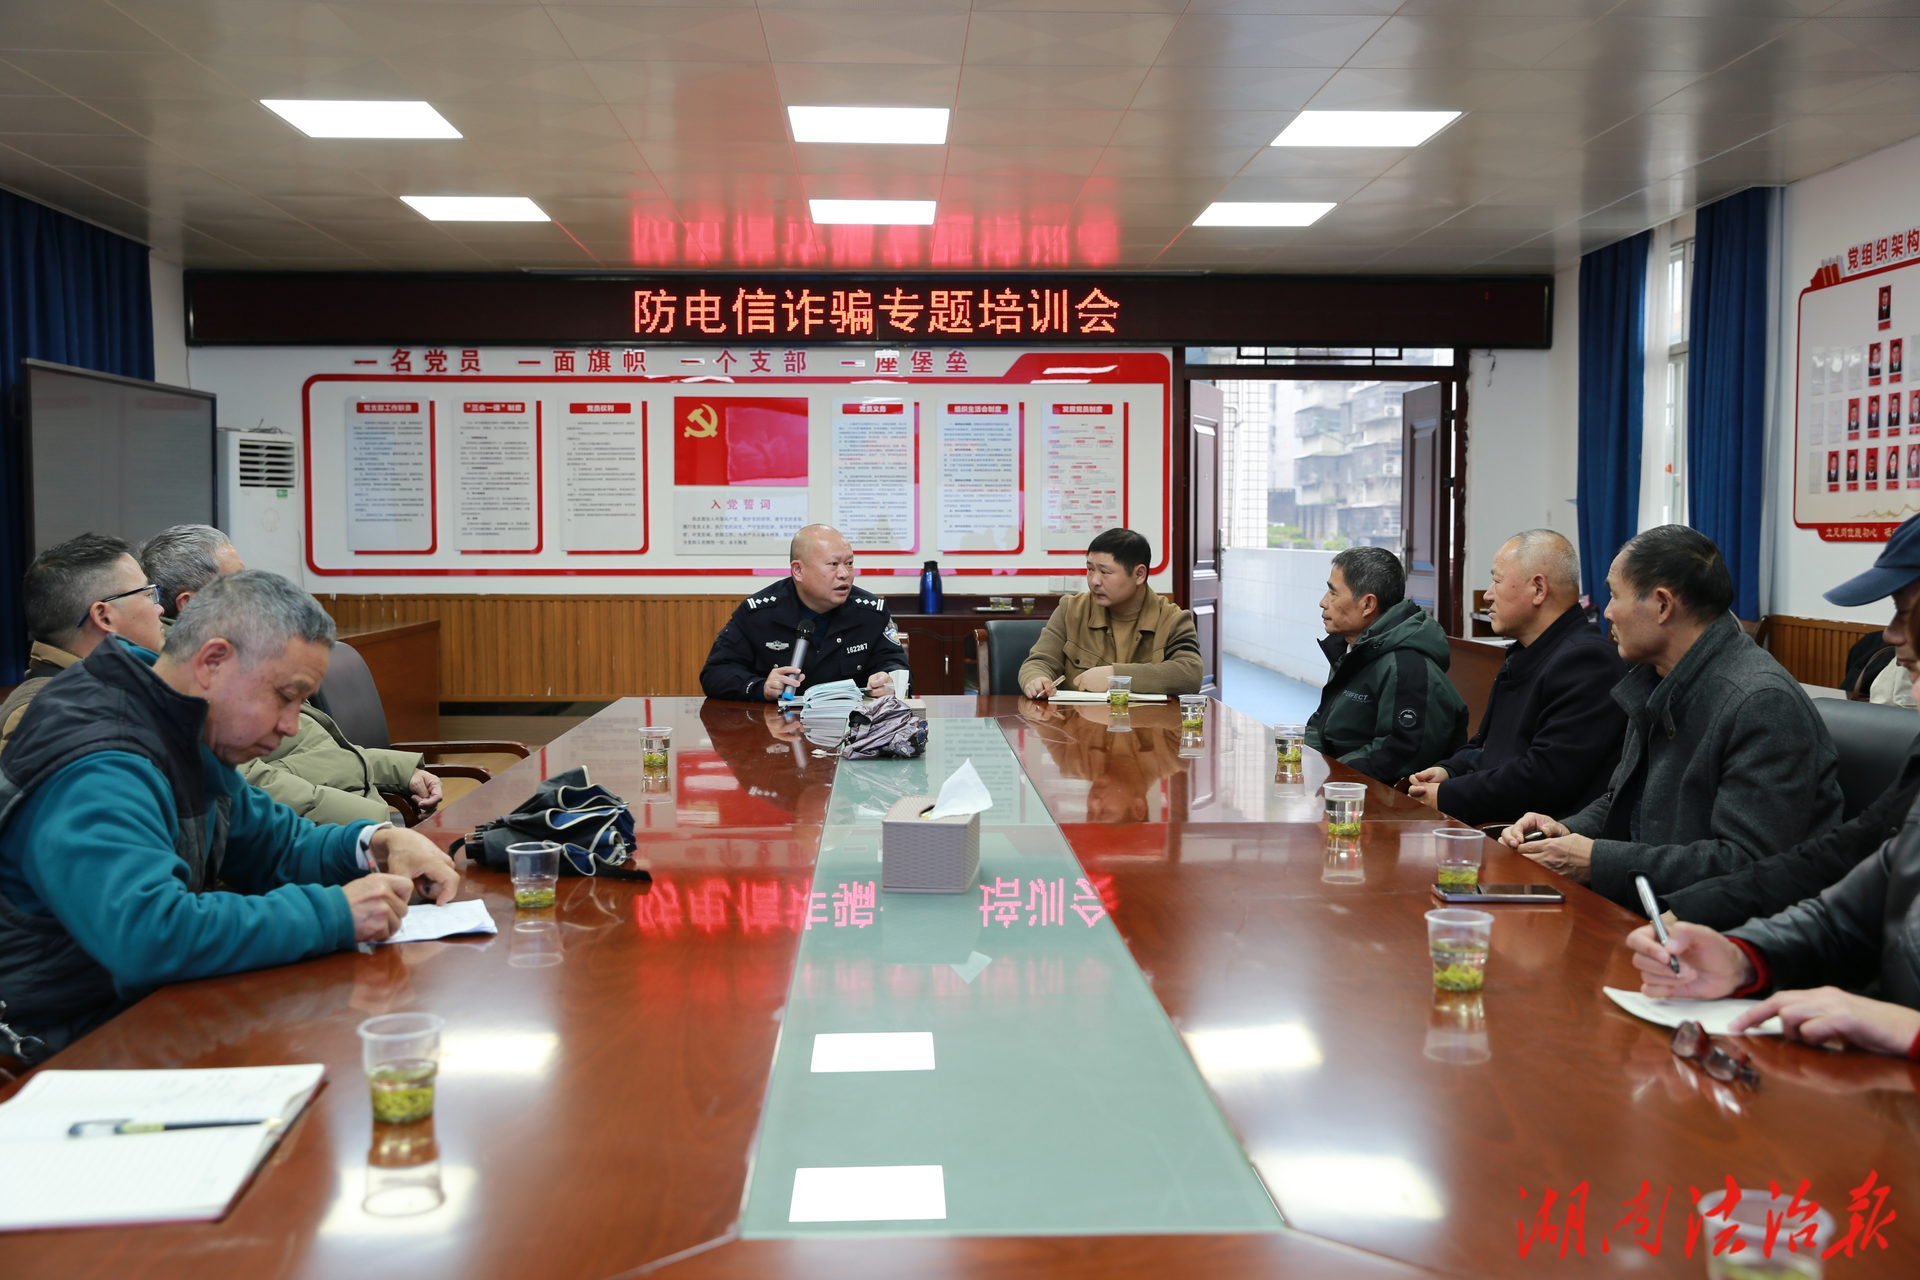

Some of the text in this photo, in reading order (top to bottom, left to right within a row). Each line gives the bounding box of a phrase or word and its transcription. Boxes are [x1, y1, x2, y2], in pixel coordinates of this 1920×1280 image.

[1847, 228, 1920, 271] 党组织架构
[633, 287, 1121, 335] 防电信诈骗专题培训会
[354, 349, 969, 374] 一名党员 一面旗帜 一个支部 一座堡垒
[711, 499, 771, 510] 入党誓词
[846, 643, 868, 654] 162287
